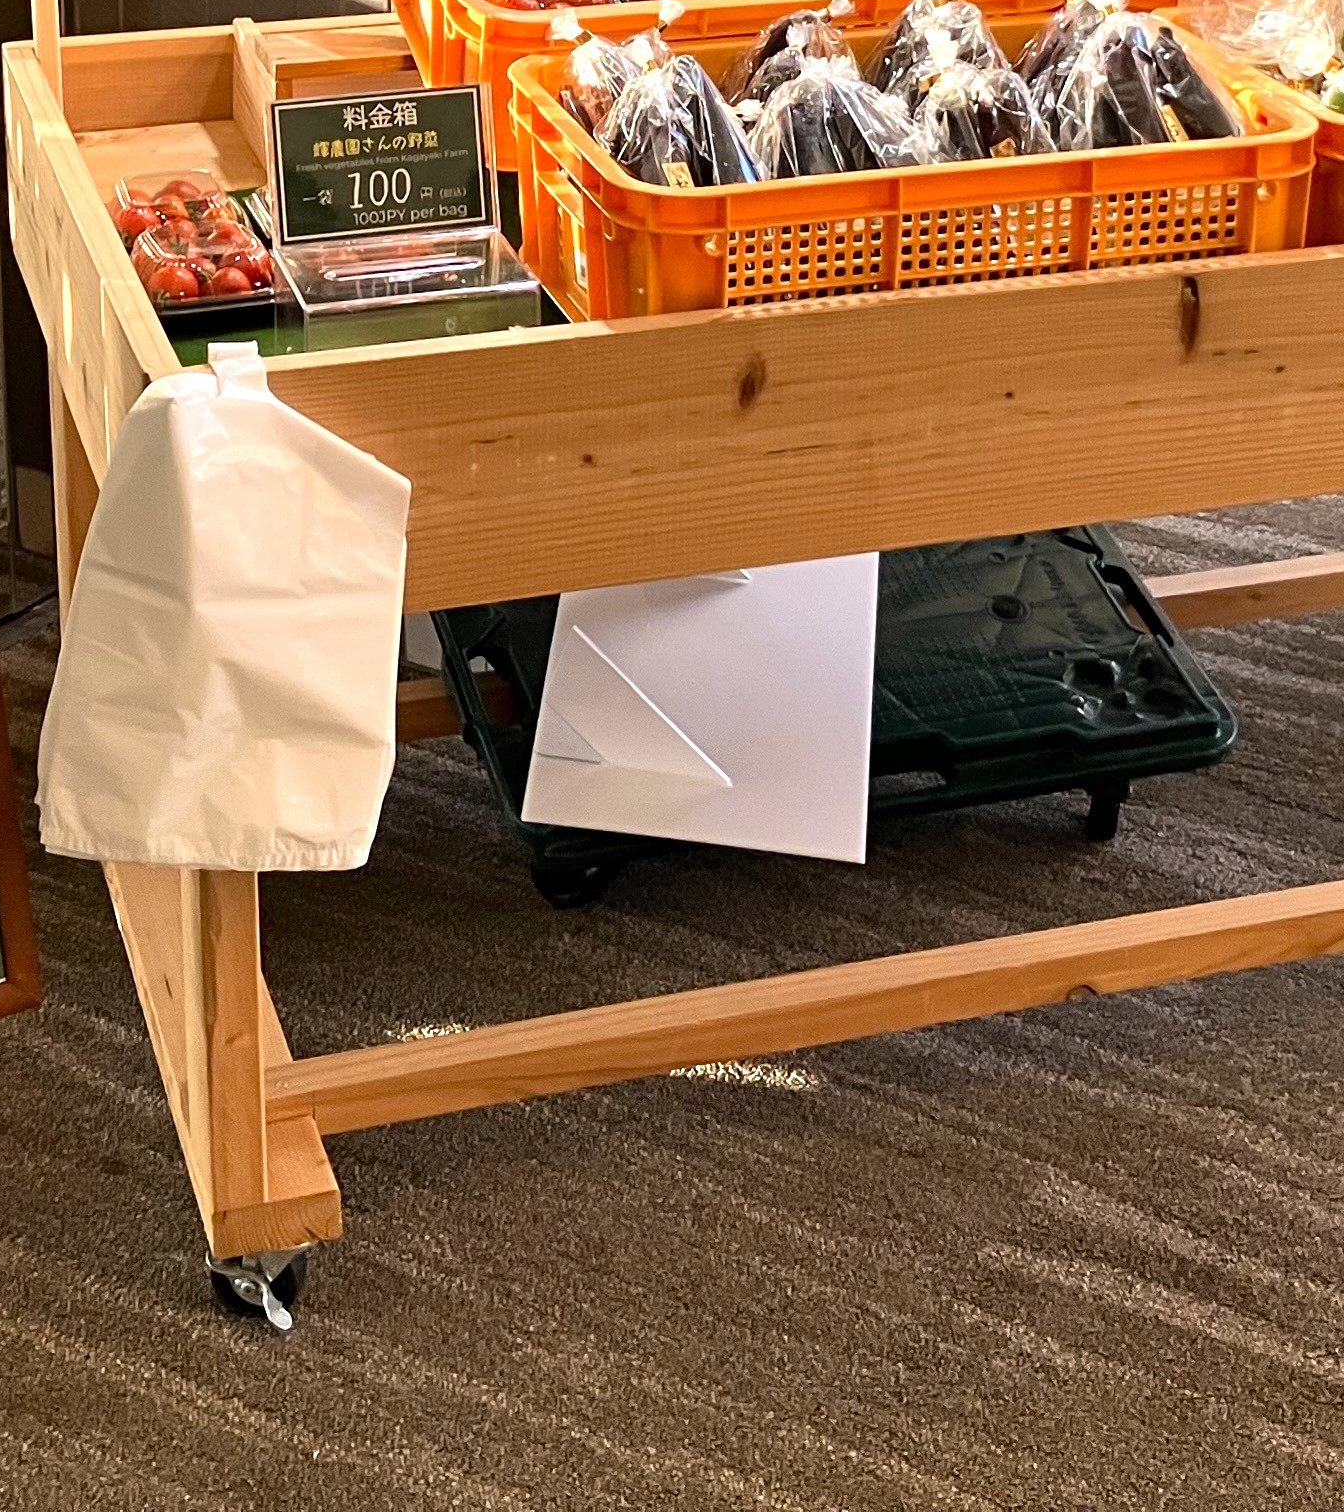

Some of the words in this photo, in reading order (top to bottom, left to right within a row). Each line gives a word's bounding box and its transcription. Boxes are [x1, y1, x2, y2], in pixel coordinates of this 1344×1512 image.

[343, 101, 418, 131] 料金箱
[312, 130, 439, 158] 輝農園さんの野菜
[375, 154, 400, 165] from
[401, 151, 443, 164] Kagayaki
[444, 148, 469, 158] Farm
[302, 188, 334, 206] 一袋
[347, 168, 412, 209] 100
[420, 186, 433, 200] 円
[353, 208, 406, 226] 100JPY
[410, 207, 435, 222] per
[439, 203, 468, 218] bag
